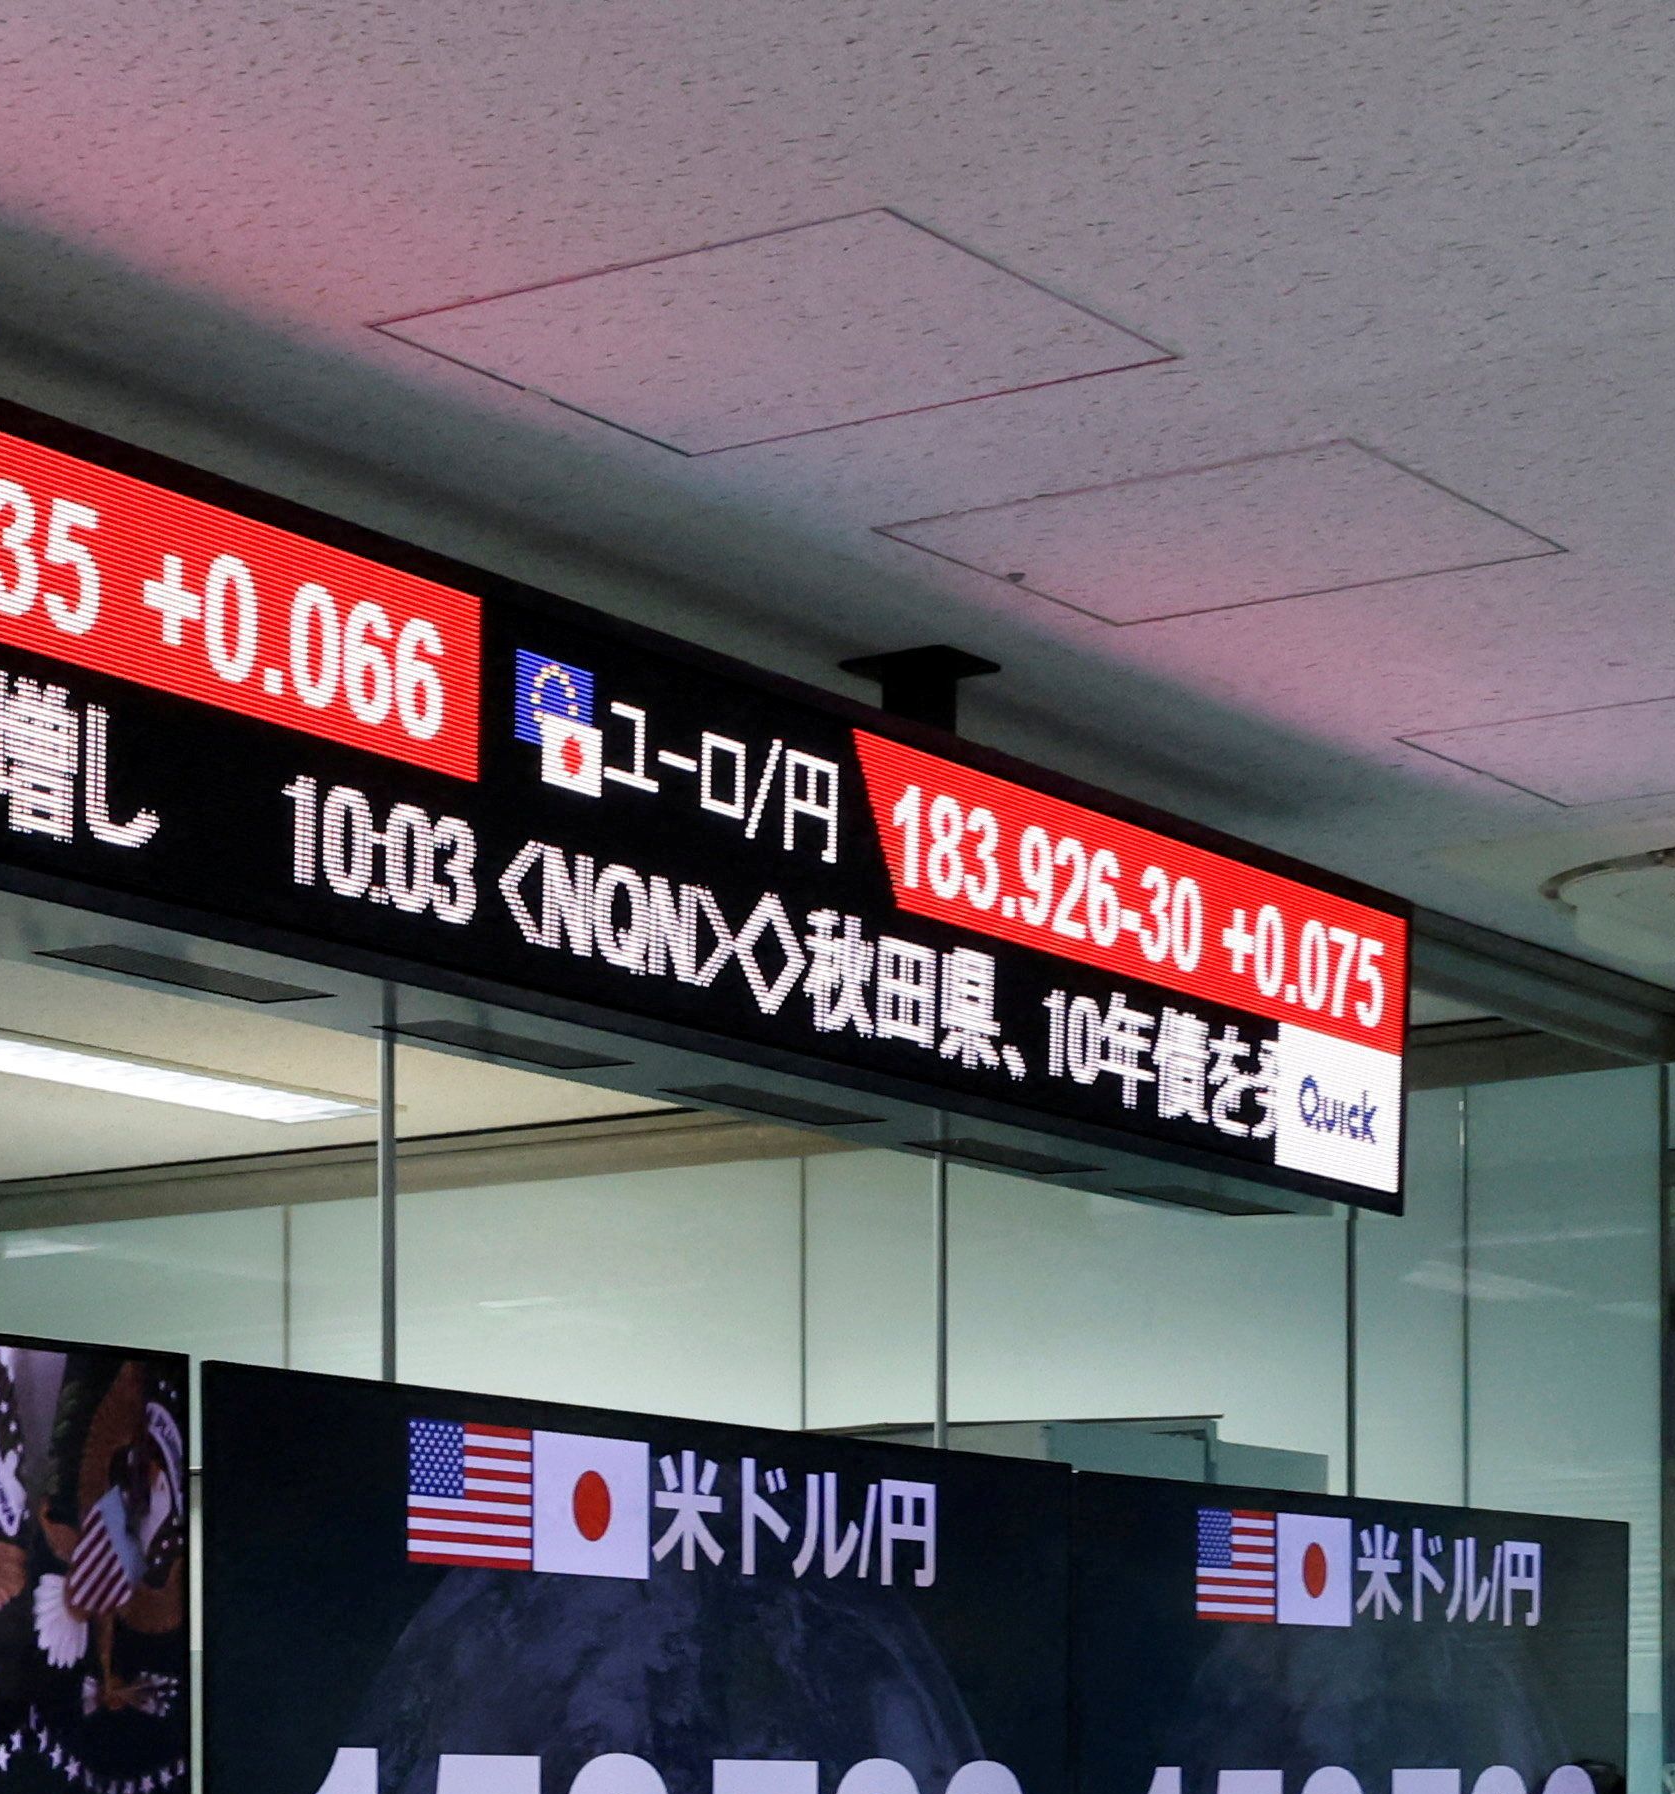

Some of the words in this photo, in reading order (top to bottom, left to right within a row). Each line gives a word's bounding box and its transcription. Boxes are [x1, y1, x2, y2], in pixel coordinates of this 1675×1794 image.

[143, 552, 446, 742] +0.066
[282, 774, 477, 926] 10:03
[888, 783, 1203, 973] 183.926-30
[1223, 904, 1386, 1029] +0.075
[651, 1449, 938, 1588] 米ドル/円
[1356, 1523, 1543, 1628] 米ドル/円
